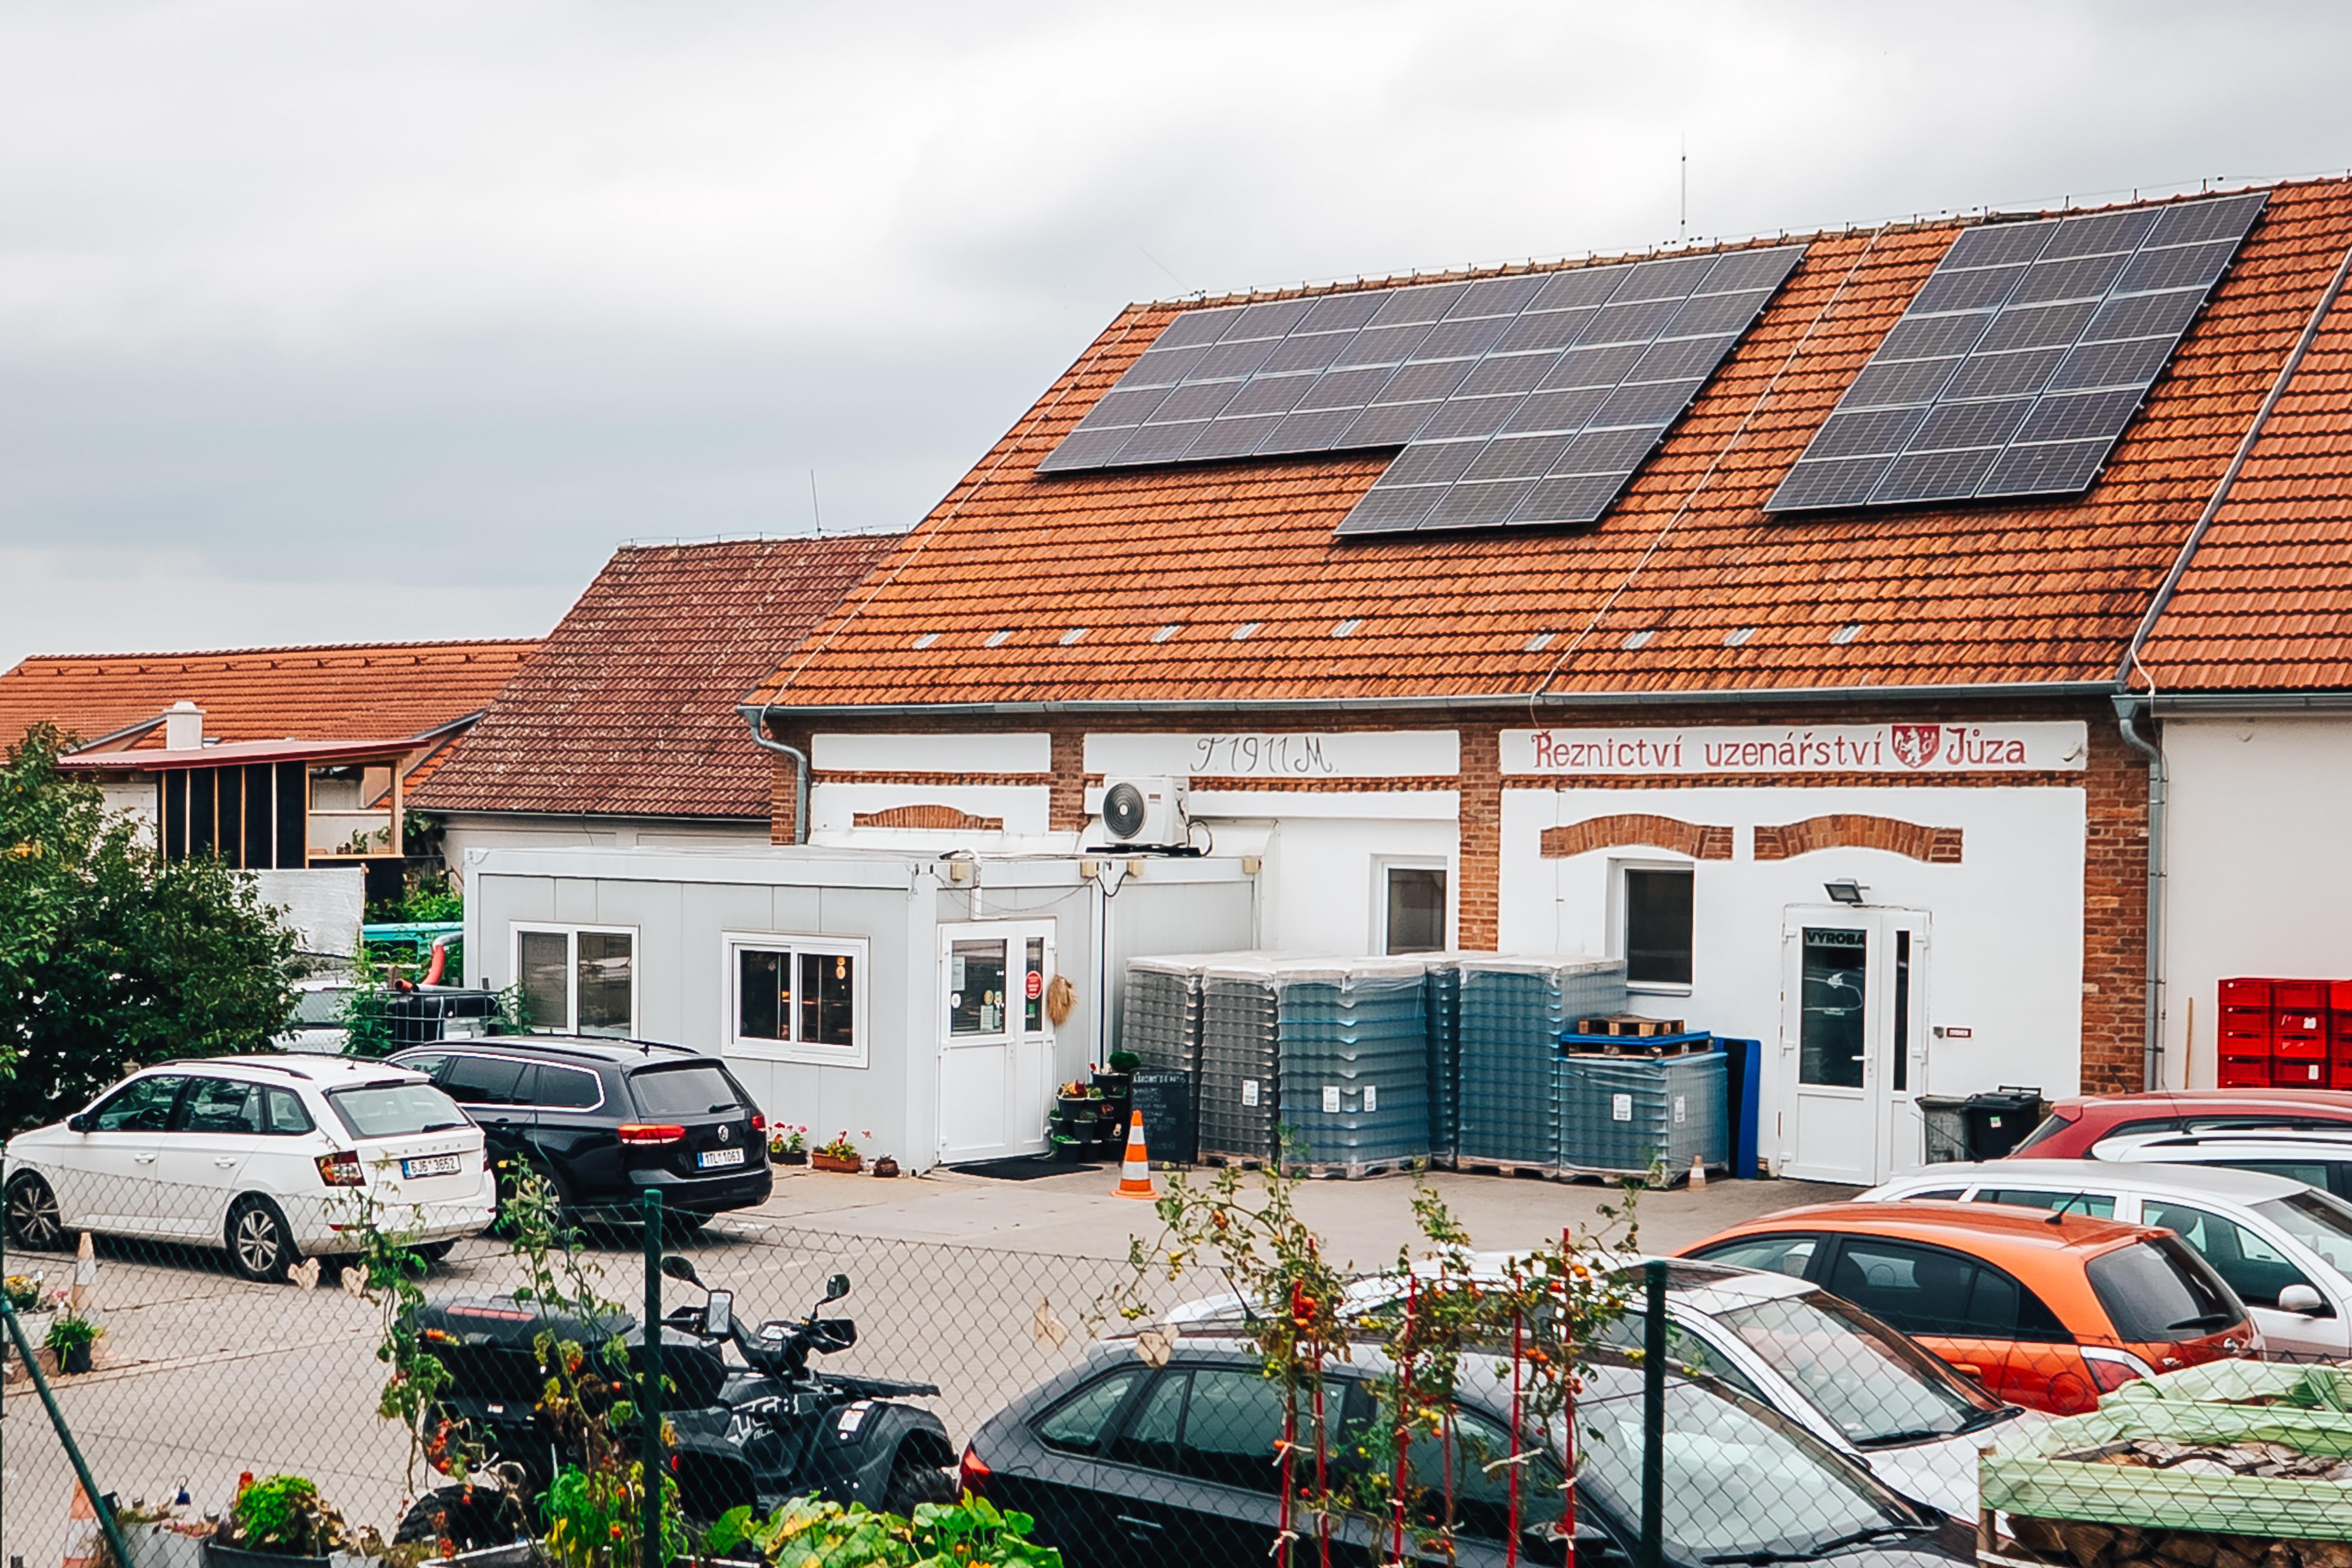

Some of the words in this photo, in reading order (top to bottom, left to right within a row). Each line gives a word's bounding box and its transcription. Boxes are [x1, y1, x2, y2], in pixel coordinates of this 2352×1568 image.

[1229, 737, 1291, 773] 1911
[1532, 730, 1683, 767] Řeznictví
[1705, 731, 1883, 766] uzenářství
[1945, 728, 2026, 765] Jůza
